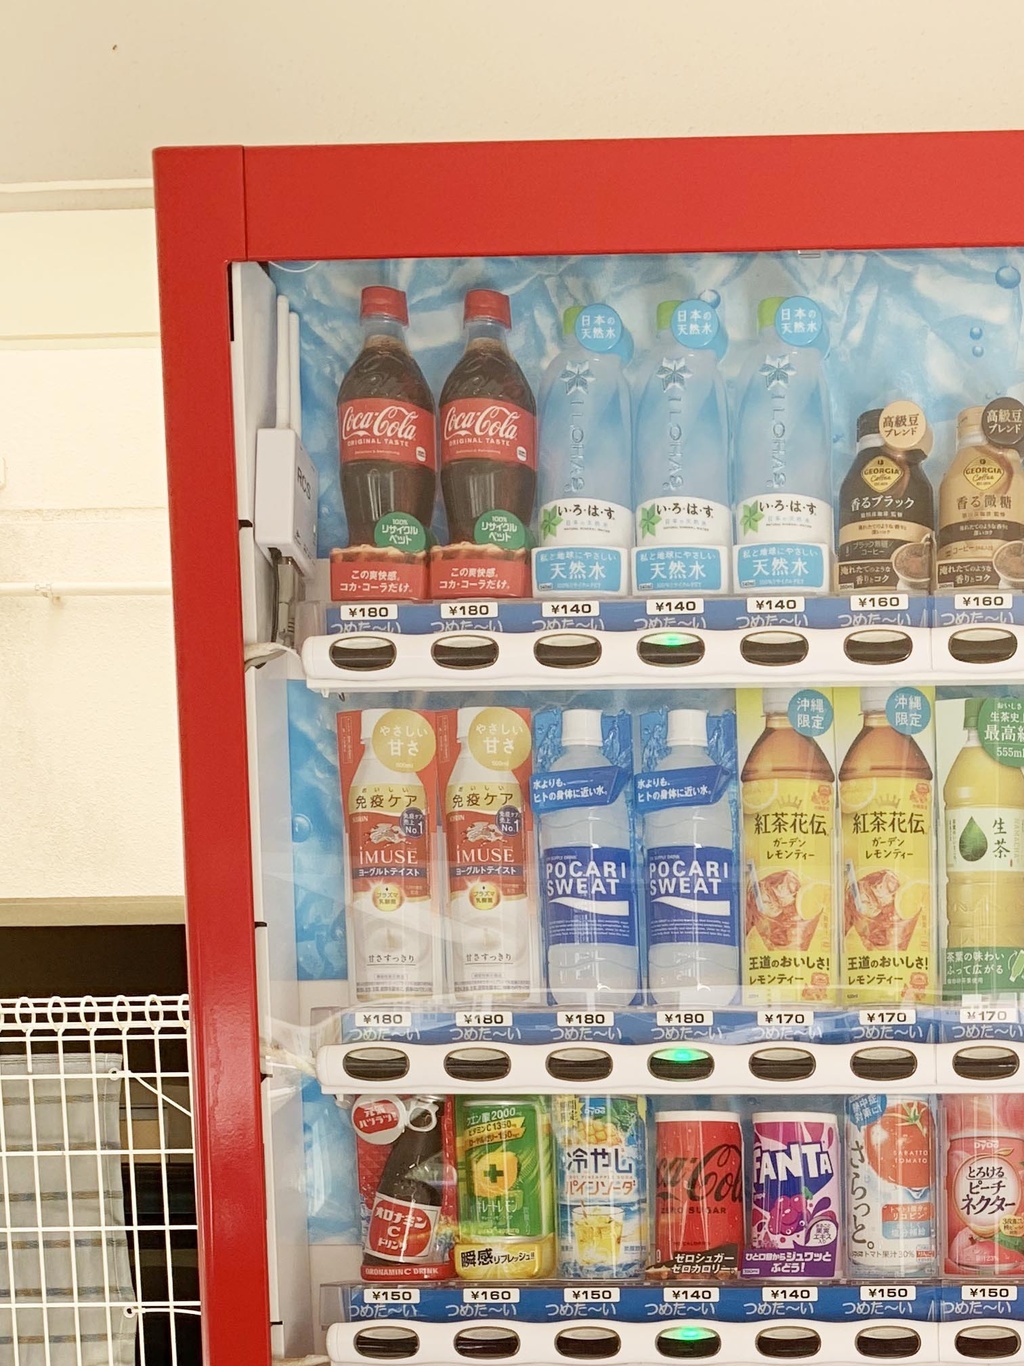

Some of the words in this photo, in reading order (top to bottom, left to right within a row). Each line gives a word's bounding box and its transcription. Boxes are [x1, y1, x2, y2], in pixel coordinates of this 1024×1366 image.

[582, 314, 615, 326] 日本の
[581, 327, 616, 339] 天然水
[343, 405, 418, 440] Coca-Cola
[882, 413, 919, 428] 高級豆
[884, 427, 918, 437] ブレンド
[347, 437, 381, 446] ORIGINAL
[384, 439, 409, 447] TASTE
[864, 467, 900, 475] GEORGIA
[851, 495, 915, 512] 香るブラック
[957, 495, 1012, 510] 香る微糖
[382, 525, 418, 535] リサイクル
[655, 601, 696, 612] ¥140
[756, 599, 797, 610] ¥140
[858, 597, 900, 607] ¥160
[962, 596, 1004, 606] ¥160
[349, 606, 389, 618] ¥180
[449, 605, 489, 616] ¥180
[551, 603, 592, 614] ¥140
[796, 697, 825, 713] 沖縄
[797, 713, 825, 729] 限定
[355, 795, 417, 809] 免疫ケア
[754, 812, 827, 836] 紅茶花伝
[992, 817, 1011, 859] 生茶
[359, 846, 418, 864] iMUSE
[767, 849, 815, 859] レモンティー
[358, 867, 420, 877] ヨーグルトテイスト
[547, 861, 626, 879] POCARI
[547, 878, 619, 895] SWEAT
[749, 956, 830, 971] 王道のおいしさ!
[363, 1014, 403, 1024] ¥180
[464, 1014, 504, 1024] ¥180
[565, 1013, 605, 1024] ¥180
[664, 1013, 704, 1024] ¥180
[764, 1013, 805, 1024] ¥170
[867, 1012, 907, 1022] ¥170
[567, 1147, 633, 1174] 冷やし
[754, 1143, 833, 1185] FANTA
[968, 1166, 1005, 1180] とろける
[969, 1181, 1006, 1195] ピーチ
[960, 1195, 1016, 1216] ネクター
[374, 1206, 427, 1229] オロナミン
[675, 1253, 734, 1264] ゼロシュガー
[372, 1290, 412, 1301] ¥150
[471, 1290, 511, 1300] ¥160
[572, 1290, 612, 1300] ¥150
[672, 1289, 712, 1299] ¥140
[771, 1289, 811, 1299] ¥140
[868, 1288, 908, 1298] ¥150
[969, 1287, 1010, 1298] ¥150
